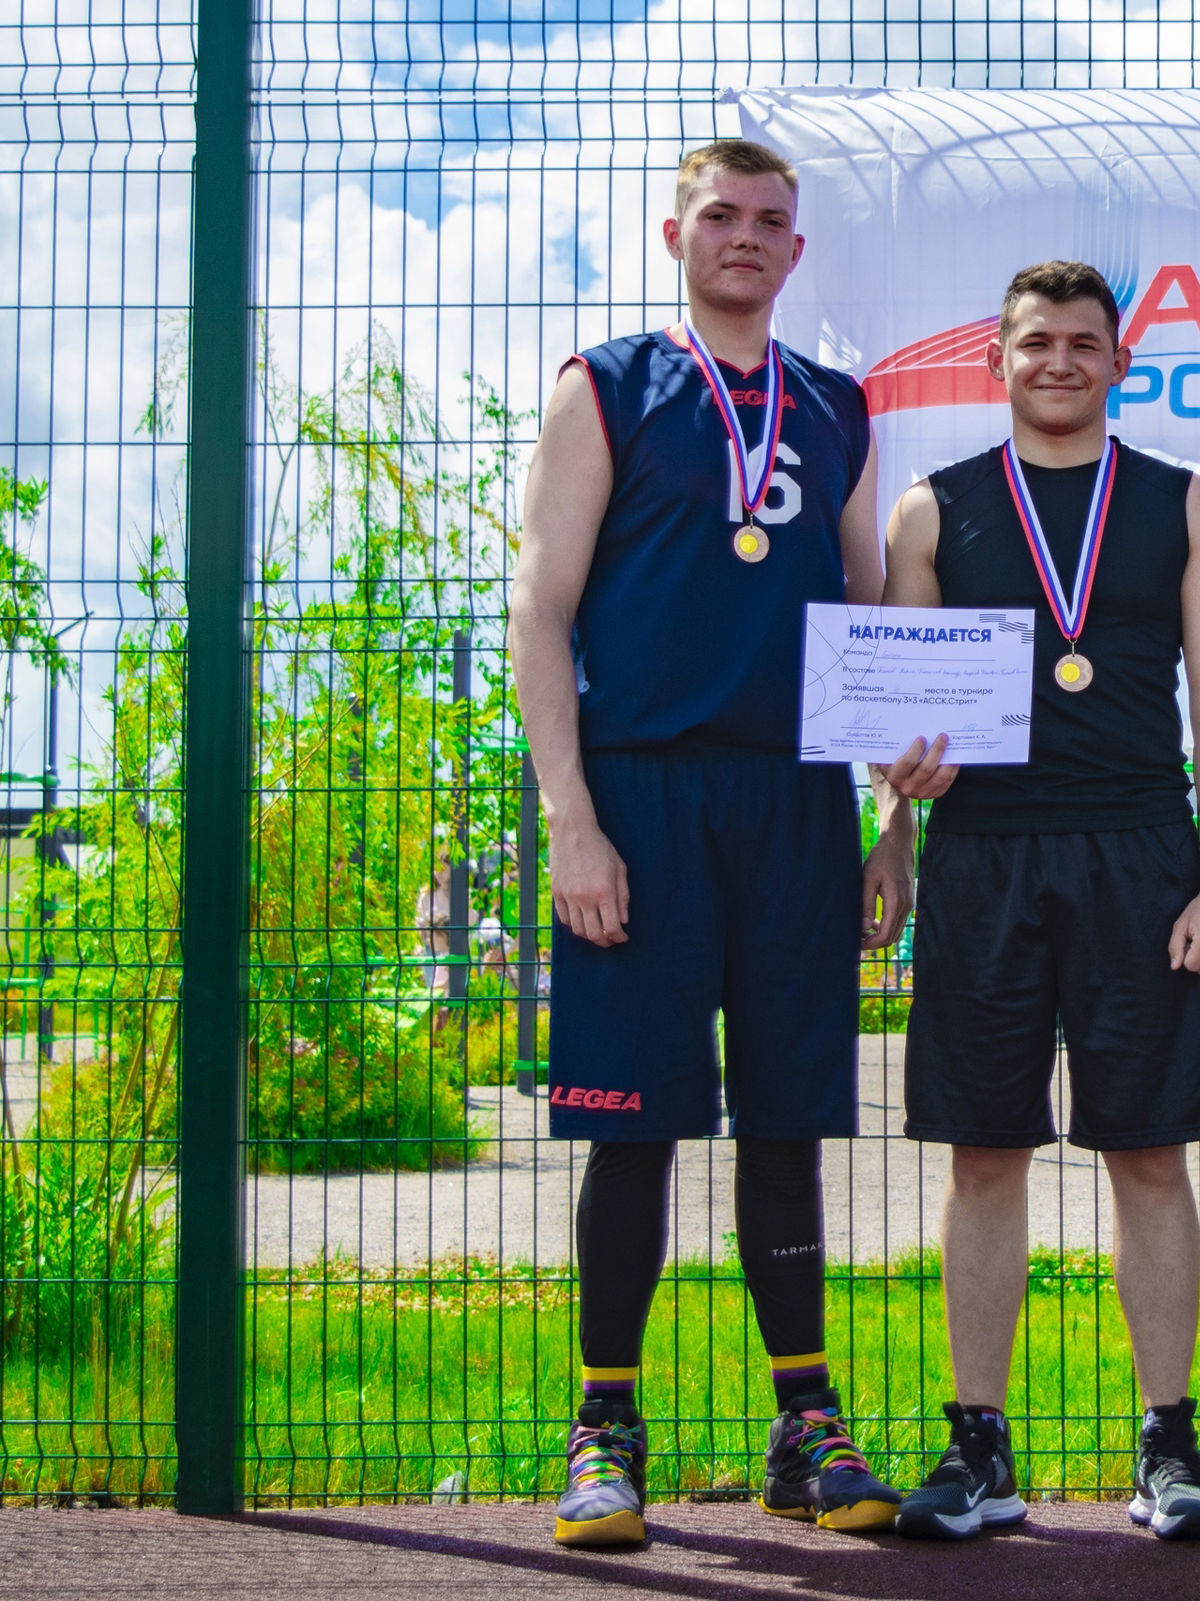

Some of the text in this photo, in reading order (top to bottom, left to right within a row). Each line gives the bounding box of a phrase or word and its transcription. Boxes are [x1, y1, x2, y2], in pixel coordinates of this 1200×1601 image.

[849, 625, 991, 644] НАГРАЖДАЕТСЯ
[958, 688, 993, 696] турнире
[853, 695, 902, 704] баскетболу
[550, 1086, 642, 1111] LEGEA
